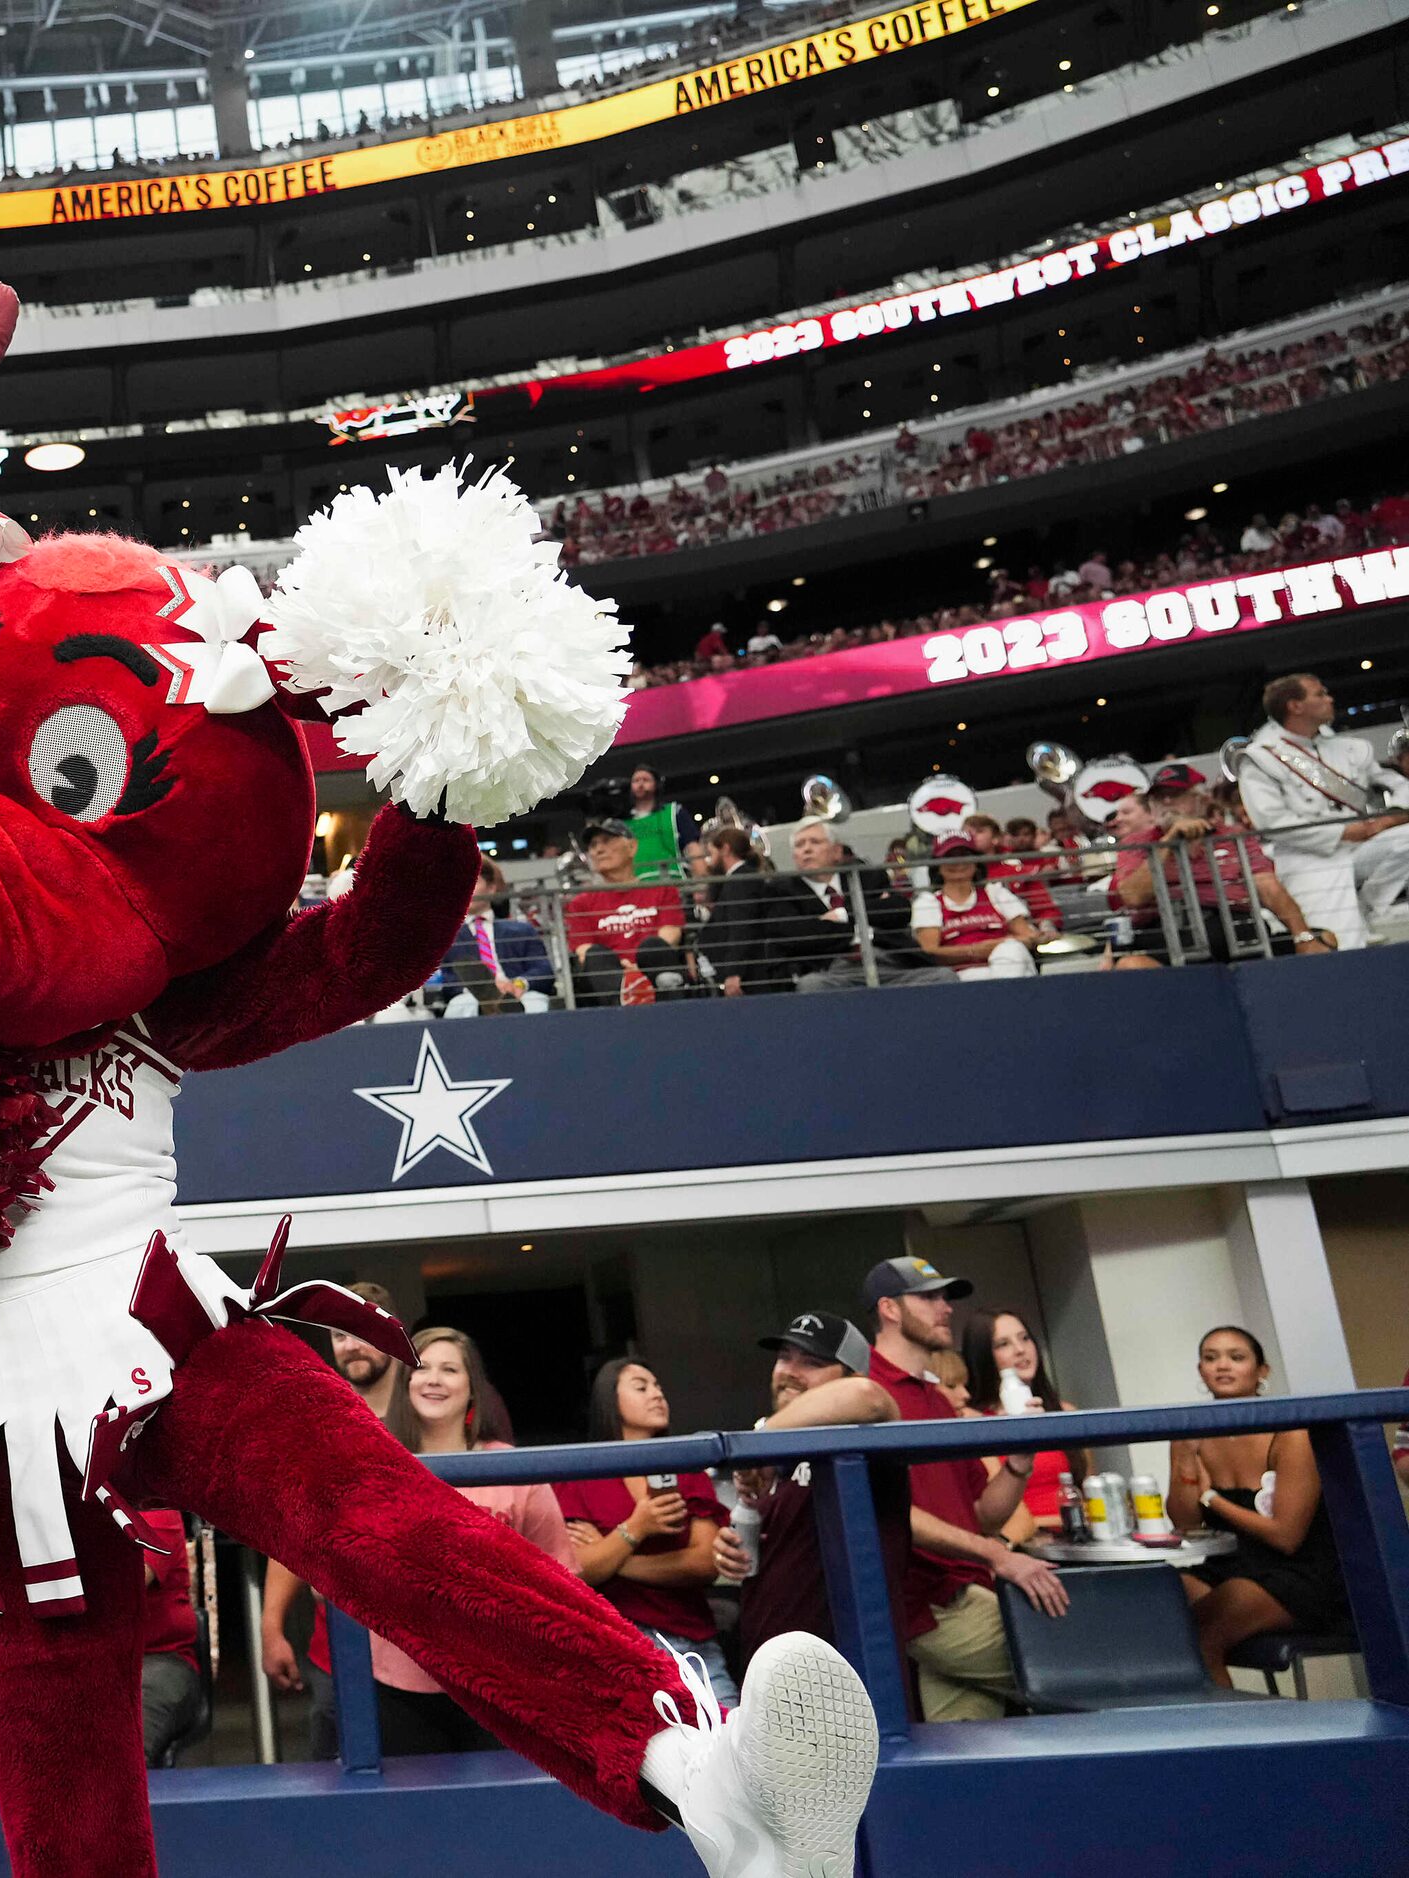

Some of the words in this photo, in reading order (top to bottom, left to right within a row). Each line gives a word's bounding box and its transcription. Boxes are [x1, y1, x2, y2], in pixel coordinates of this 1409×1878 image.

[675, 31, 856, 115] AMERICA'S
[51, 176, 212, 224] AMERICA'S
[224, 159, 337, 207] COFFEE
[723, 318, 825, 370] 2023
[829, 241, 1099, 343] SOUTHWEST
[1108, 174, 1311, 264] CLASSIC
[922, 611, 1089, 683] 2023
[131, 1367, 152, 1395] S
